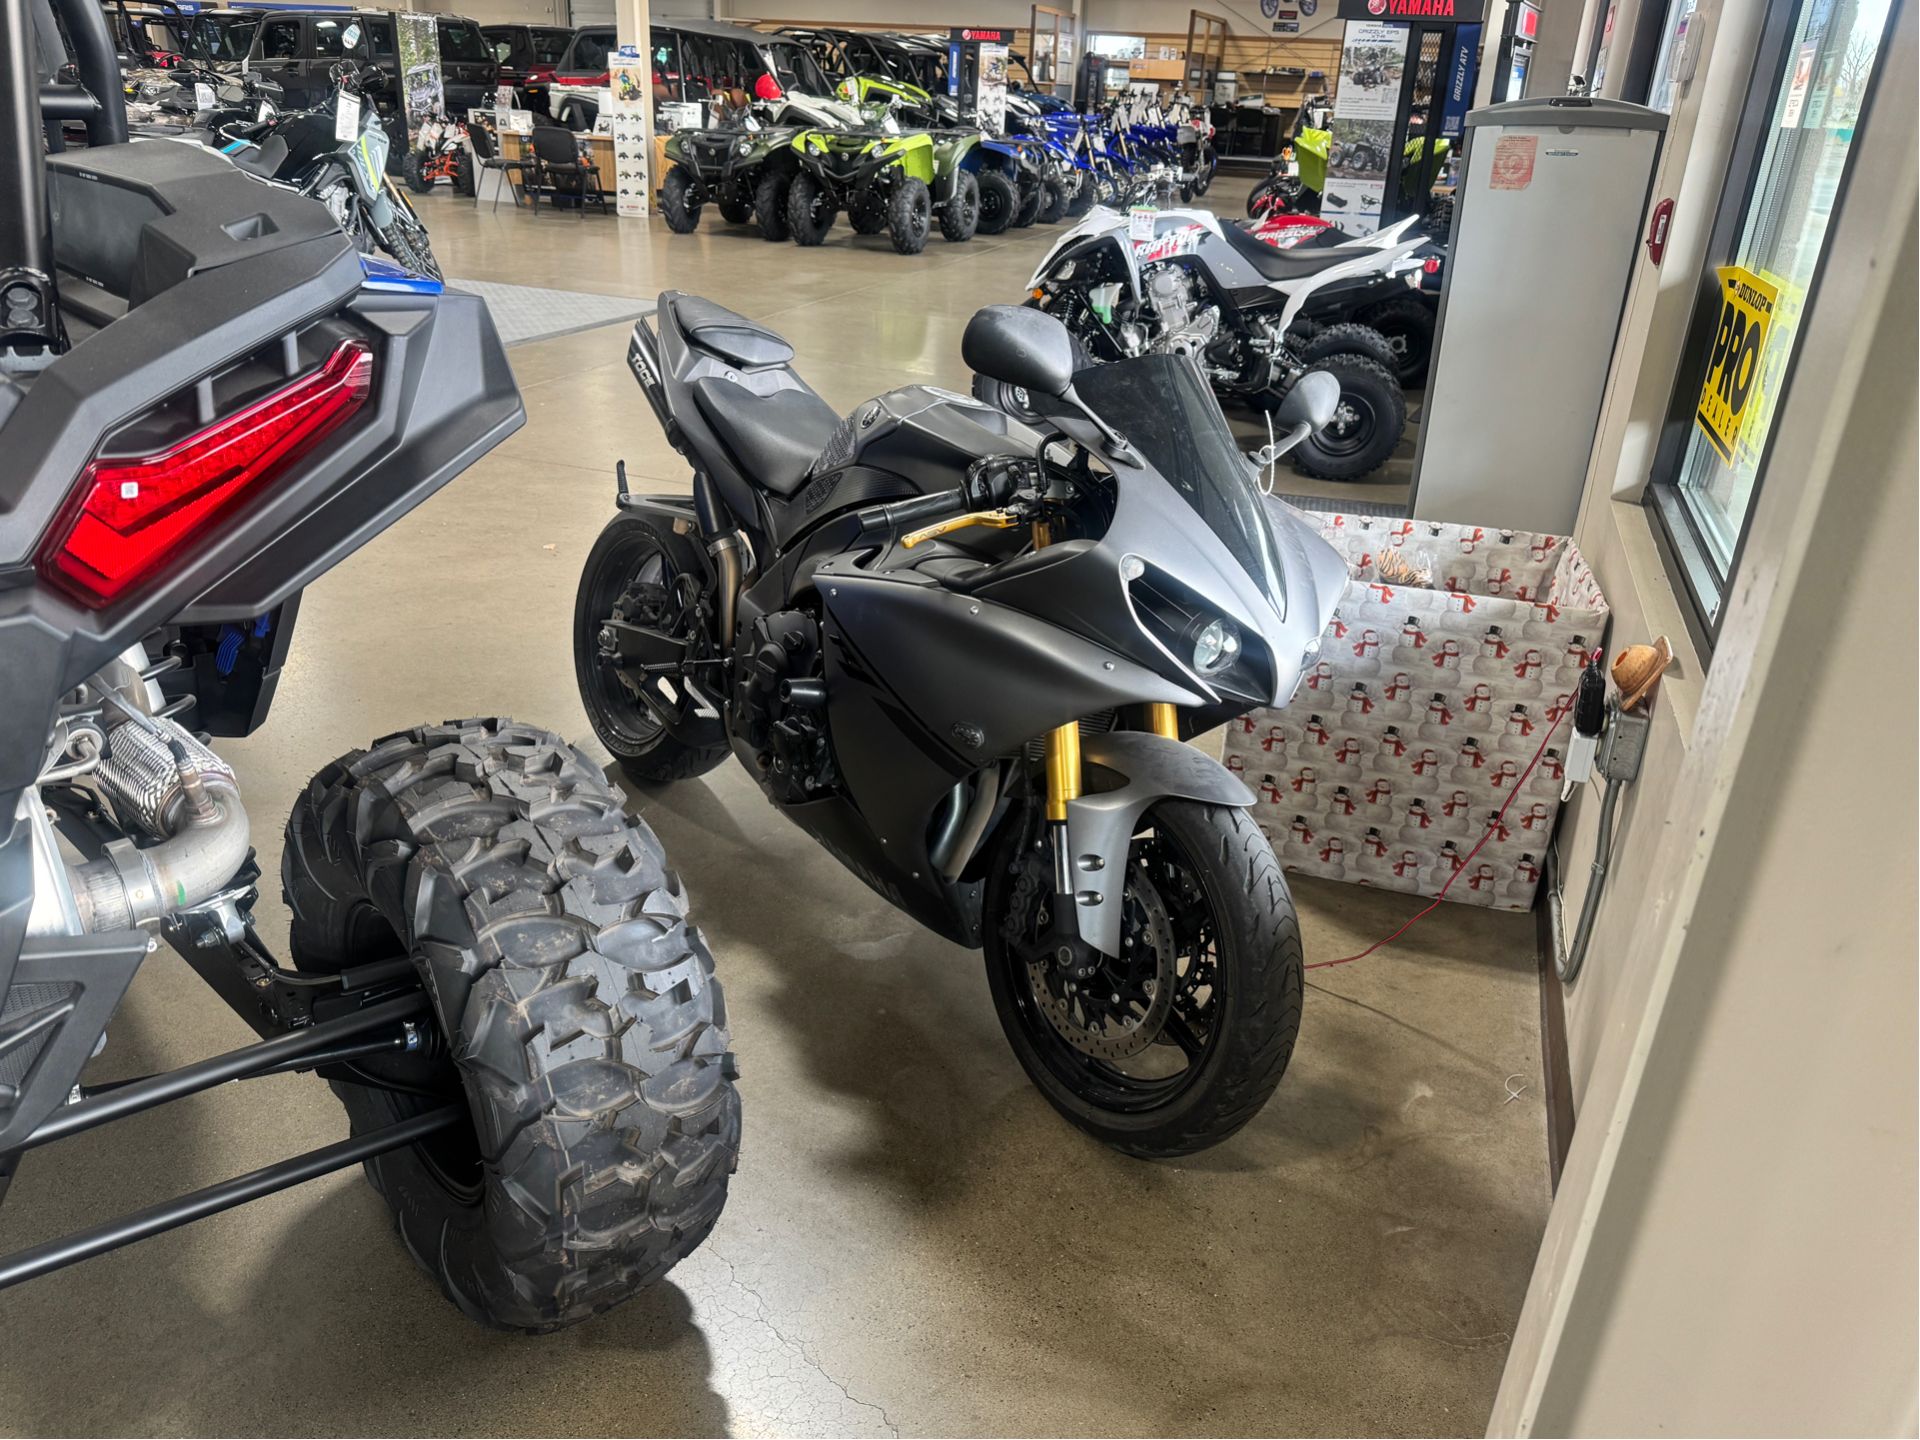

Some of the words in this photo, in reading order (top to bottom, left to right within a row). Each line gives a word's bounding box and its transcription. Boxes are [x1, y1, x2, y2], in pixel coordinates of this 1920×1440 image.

[1387, 0, 1456, 16] YAMAHA
[970, 31, 1001, 41] YAMAHA
[1452, 67, 1466, 102] GRIZZLY
[1459, 47, 1470, 67] ATV
[1739, 283, 1767, 313] DUNLOP
[631, 353, 656, 388] TOCE
[1706, 300, 1761, 416] PRO
[1700, 387, 1739, 447] DEALER
